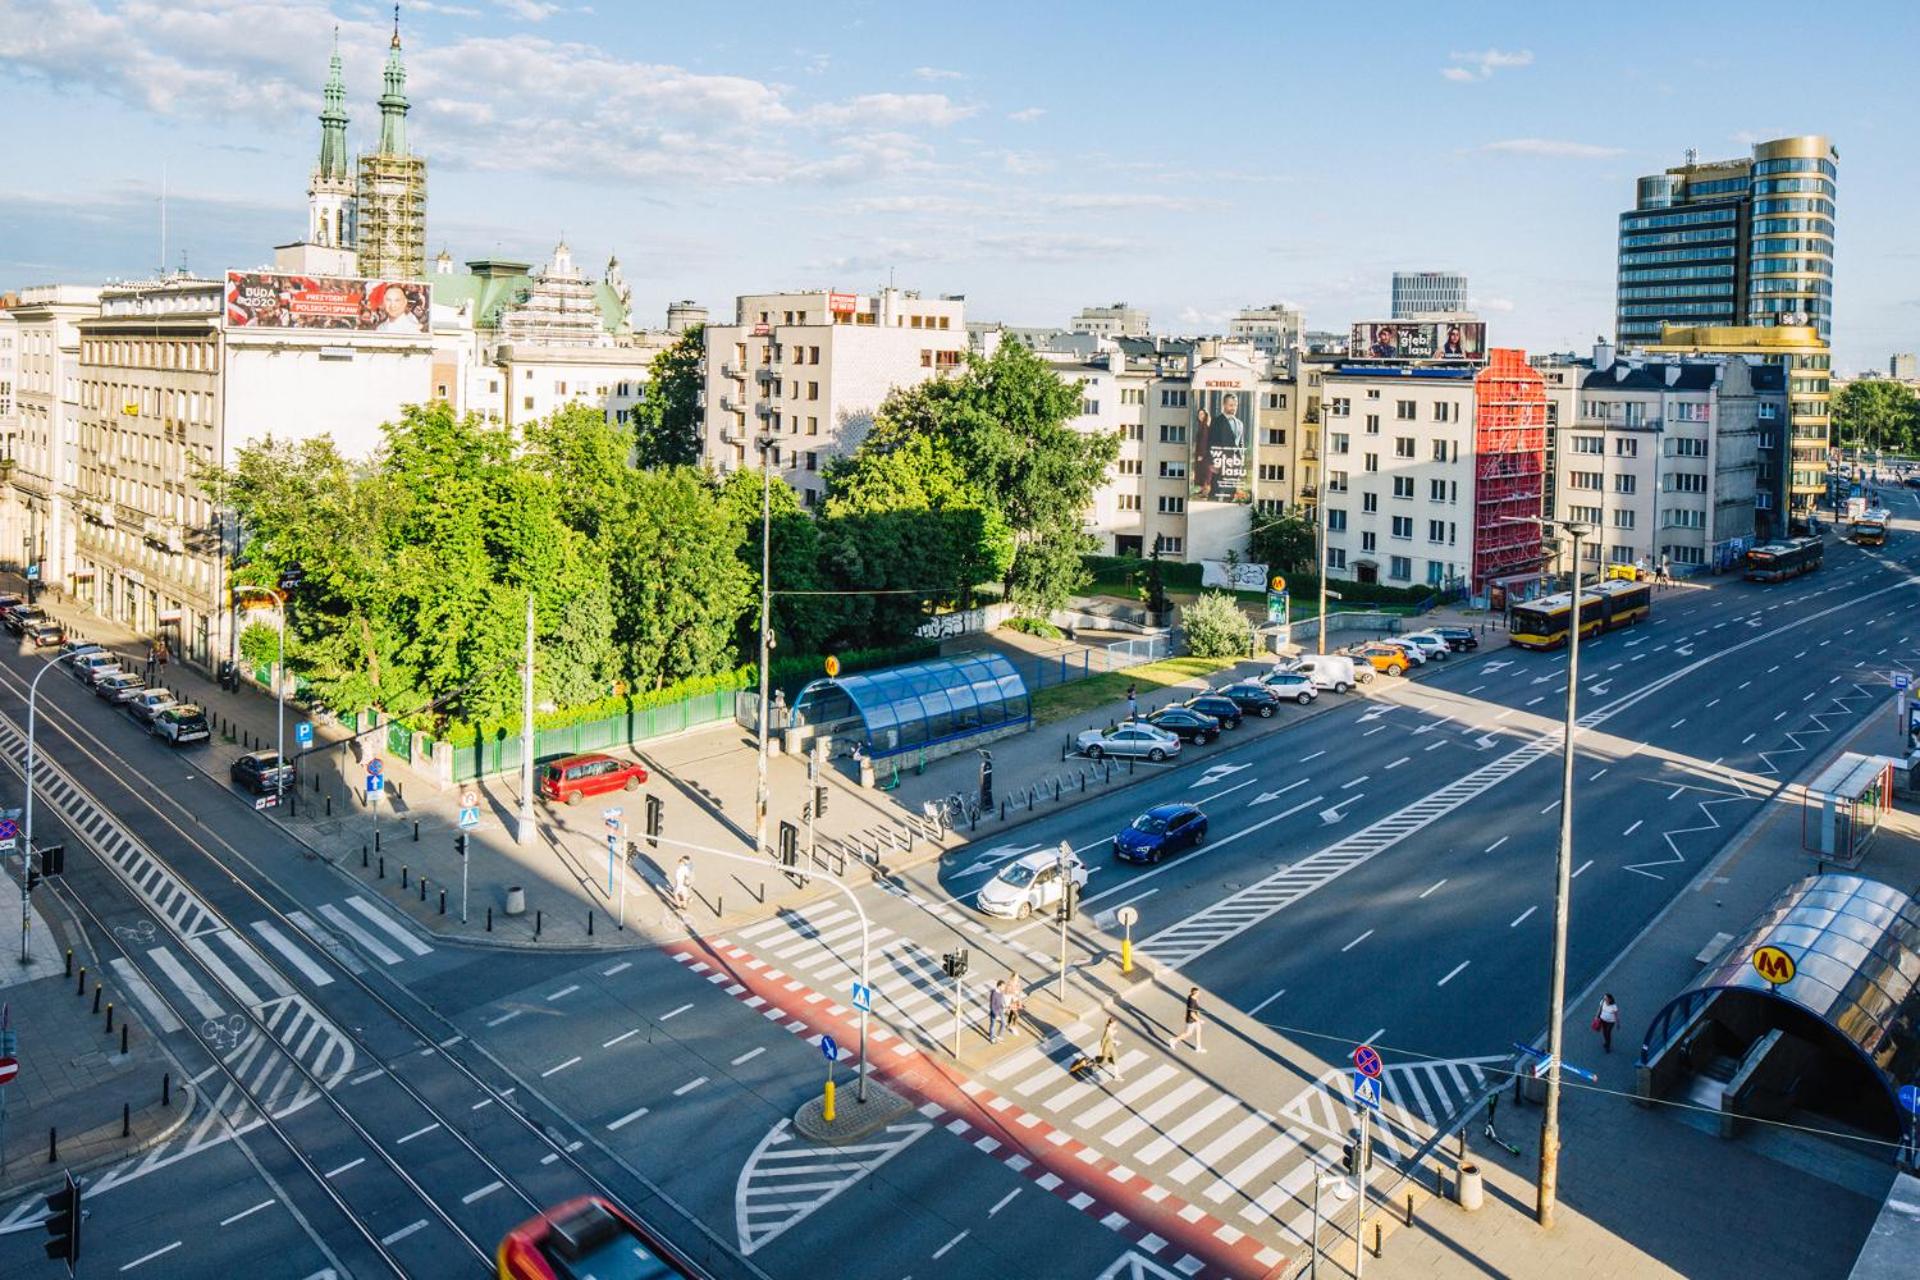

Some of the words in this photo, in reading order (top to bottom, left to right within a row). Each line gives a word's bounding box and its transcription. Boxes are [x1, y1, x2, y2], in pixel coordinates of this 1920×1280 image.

[245, 287, 275, 298] DUDA
[305, 293, 348, 303] PREZYDENT
[245, 298, 275, 307] 2020
[296, 304, 332, 312] POLSKICH
[332, 305, 358, 313] SPRAW
[1408, 344, 1432, 355] lasu
[1221, 465, 1247, 477] lasu
[300, 724, 310, 737] P
[1758, 951, 1789, 979] M
